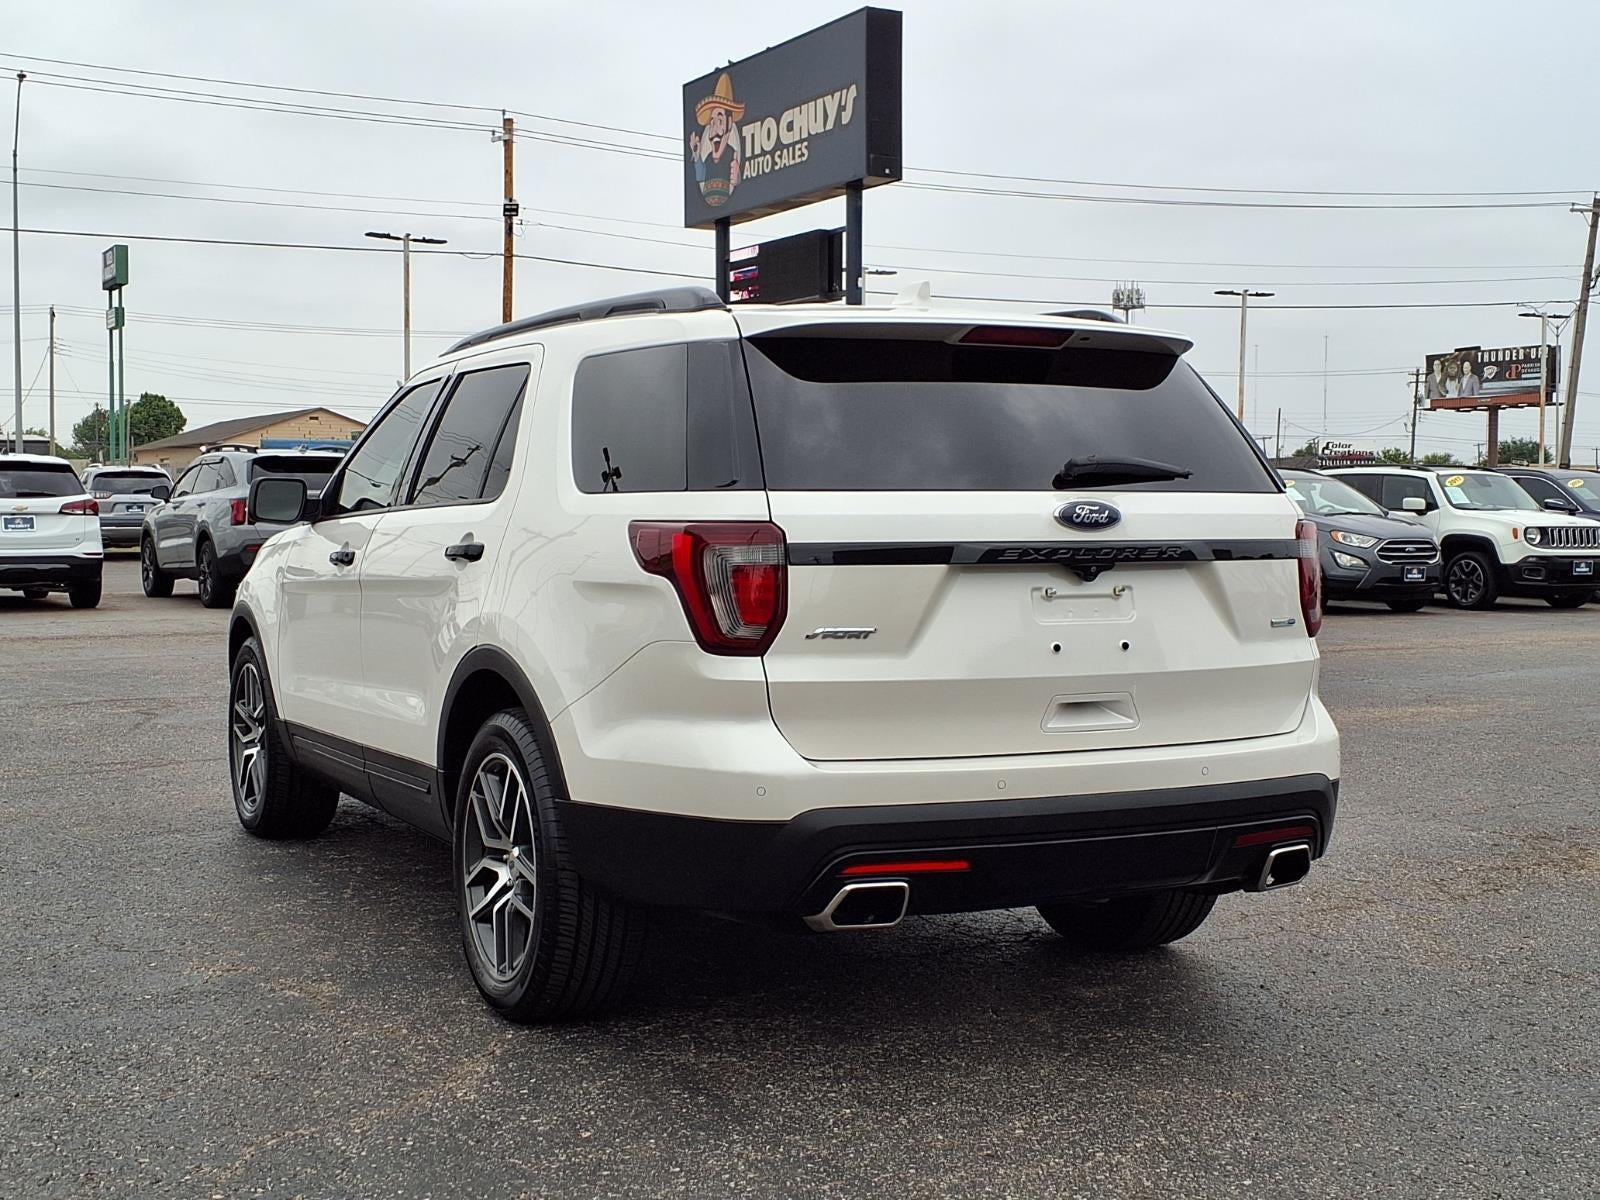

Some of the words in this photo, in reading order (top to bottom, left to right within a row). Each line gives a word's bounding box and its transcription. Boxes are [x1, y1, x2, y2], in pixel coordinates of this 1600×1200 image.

[742, 117, 777, 158] TIO
[779, 84, 857, 145] CHUY'S
[743, 154, 772, 180] AUTO
[774, 141, 809, 171] SALES
[1477, 349, 1524, 362] THUNDER
[1322, 446, 1374, 457] Creations
[1325, 441, 1353, 450] Color
[1072, 504, 1109, 523] Ford
[997, 546, 1184, 560] EXPLORER
[804, 627, 877, 640] SPORT
